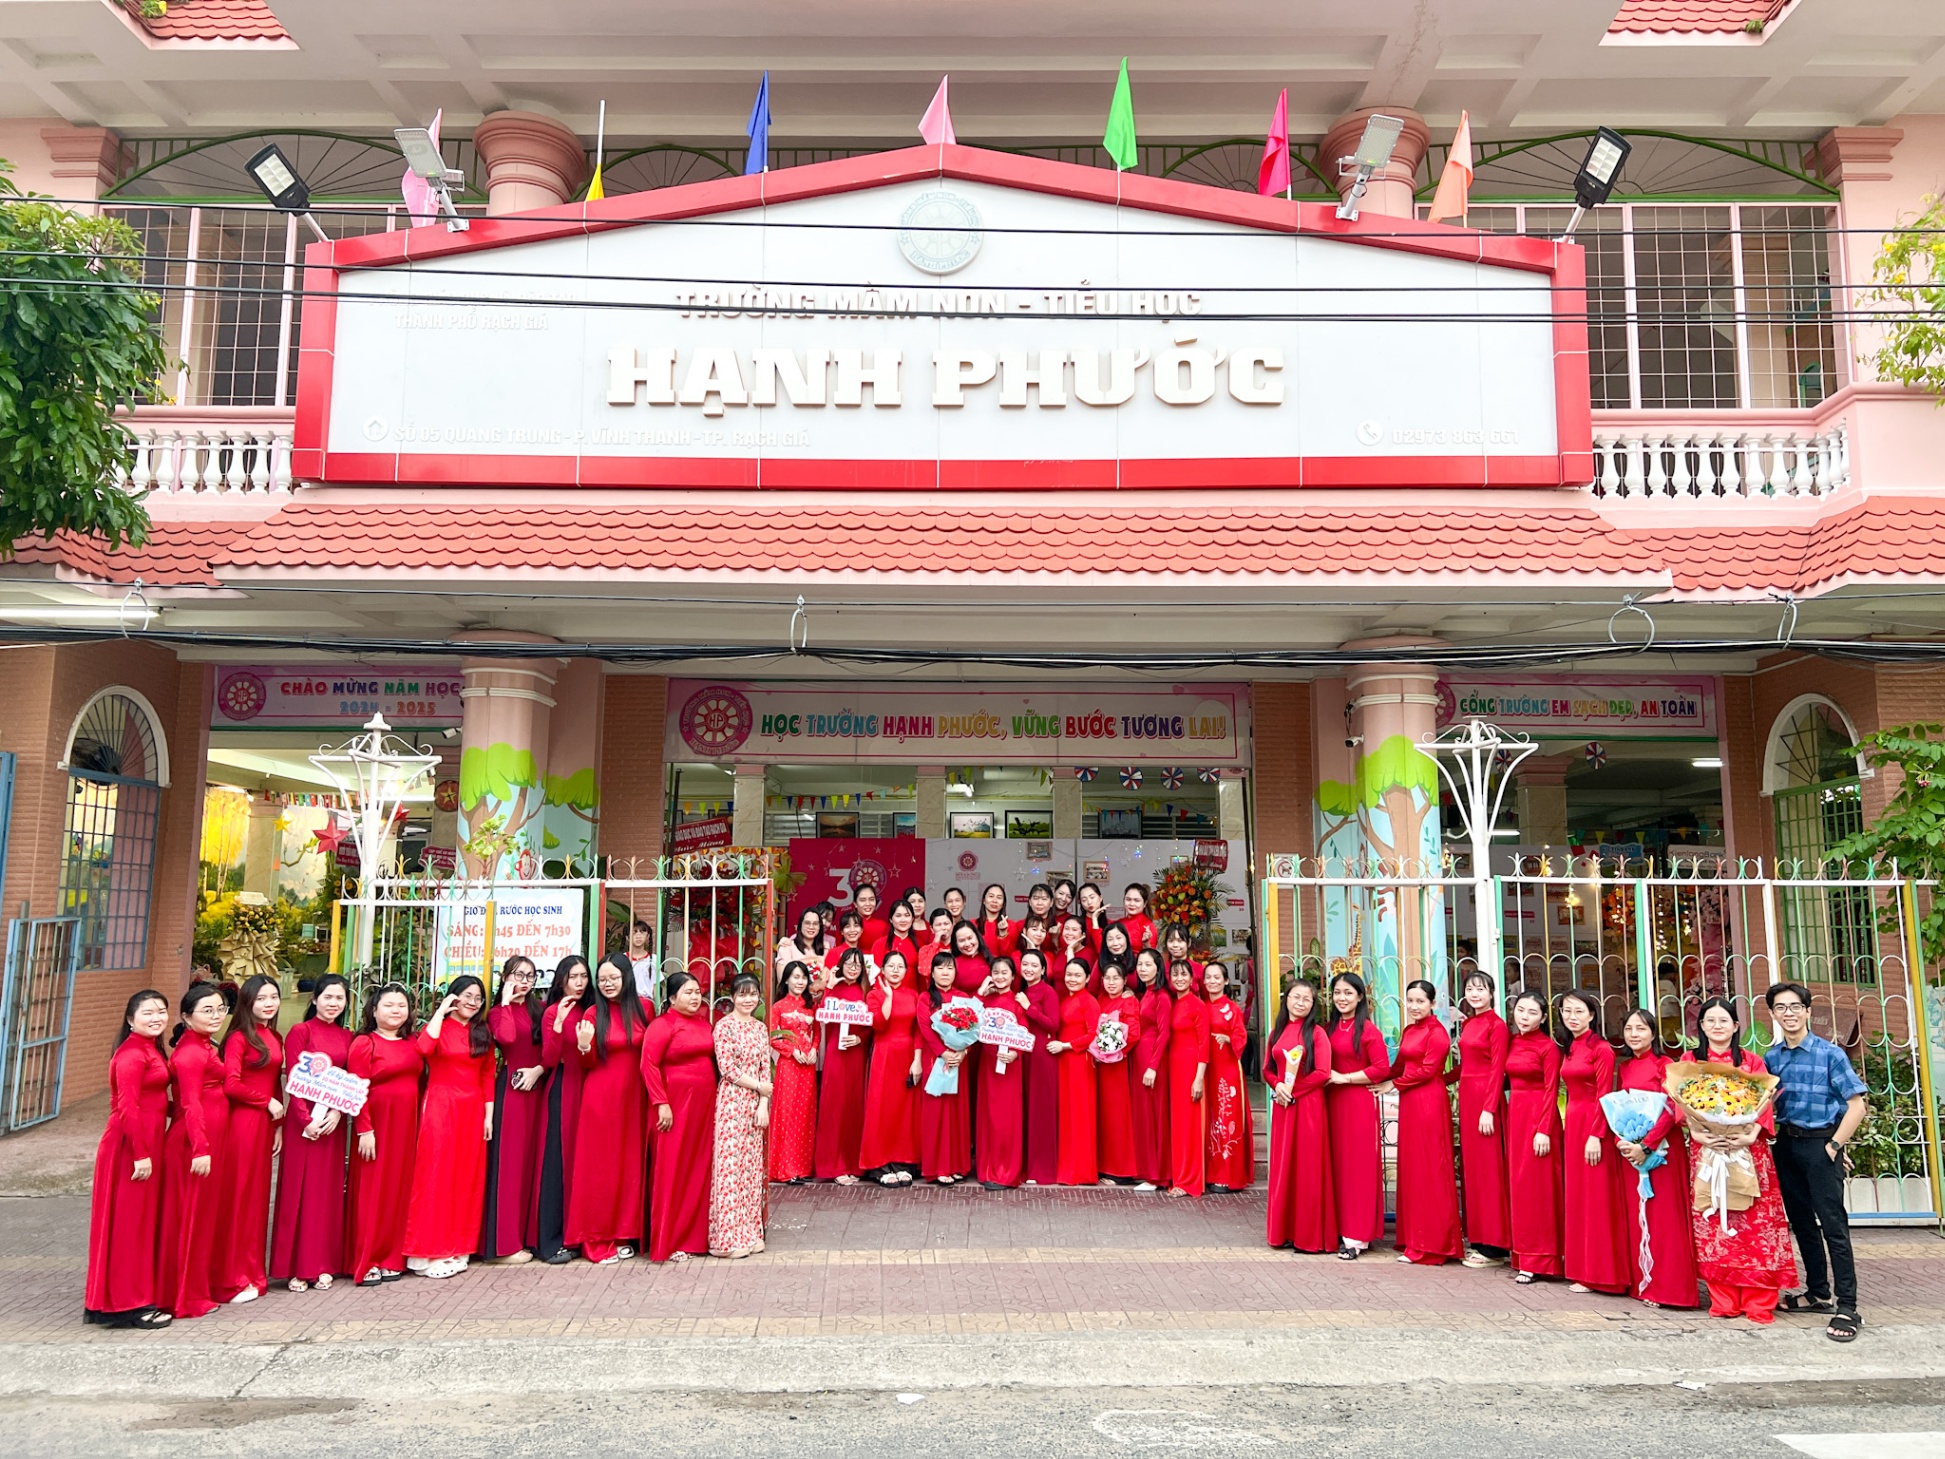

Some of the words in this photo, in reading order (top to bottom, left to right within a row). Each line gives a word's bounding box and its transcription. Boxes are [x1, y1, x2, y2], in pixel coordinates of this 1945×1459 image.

[675, 283, 815, 319] TRƯỜNG
[932, 291, 1006, 319] NON
[1131, 291, 1201, 324] HỌC
[607, 348, 902, 417] HẠNH
[932, 334, 1285, 408] PHƯỚC
[420, 428, 440, 442] 05
[445, 427, 502, 444] QUANG
[506, 429, 561, 444] TRUNG
[1392, 429, 1447, 444] 02973
[1452, 429, 1484, 444] 863
[1490, 429, 1519, 444] 661
[280, 678, 328, 696] CHÀO
[332, 677, 379, 696] MỪNG
[384, 679, 420, 696] NĂM
[425, 682, 461, 700] HỌC
[340, 701, 379, 715] 2024
[397, 701, 436, 716] 2025
[1460, 690, 1497, 715] CỔNG
[1499, 694, 1550, 716] TRƯỜNG
[1551, 699, 1571, 717] EM
[1573, 699, 1608, 721] SẠCH
[1640, 699, 1660, 717] AN
[1660, 695, 1698, 717] TOÀN
[760, 714, 800, 742] HỌC
[806, 708, 879, 737] TRƯỜNG
[882, 715, 935, 743] HẠNH
[937, 709, 1008, 740] PHƯỚC,
[1011, 709, 1062, 738] VỮNG
[1065, 709, 1117, 738] BƯỚC
[1121, 713, 1185, 739] TƯƠNG
[1188, 716, 1226, 739] LAI!
[500, 903, 523, 915] RƯỚC
[524, 906, 541, 917] HỌC
[543, 906, 563, 915] SINH
[447, 922, 484, 937] SÁNG:
[517, 919, 541, 936] ĐẾN
[545, 924, 571, 938] 7h30
[493, 945, 520, 958] 6h20
[524, 940, 549, 957] ĐẾN
